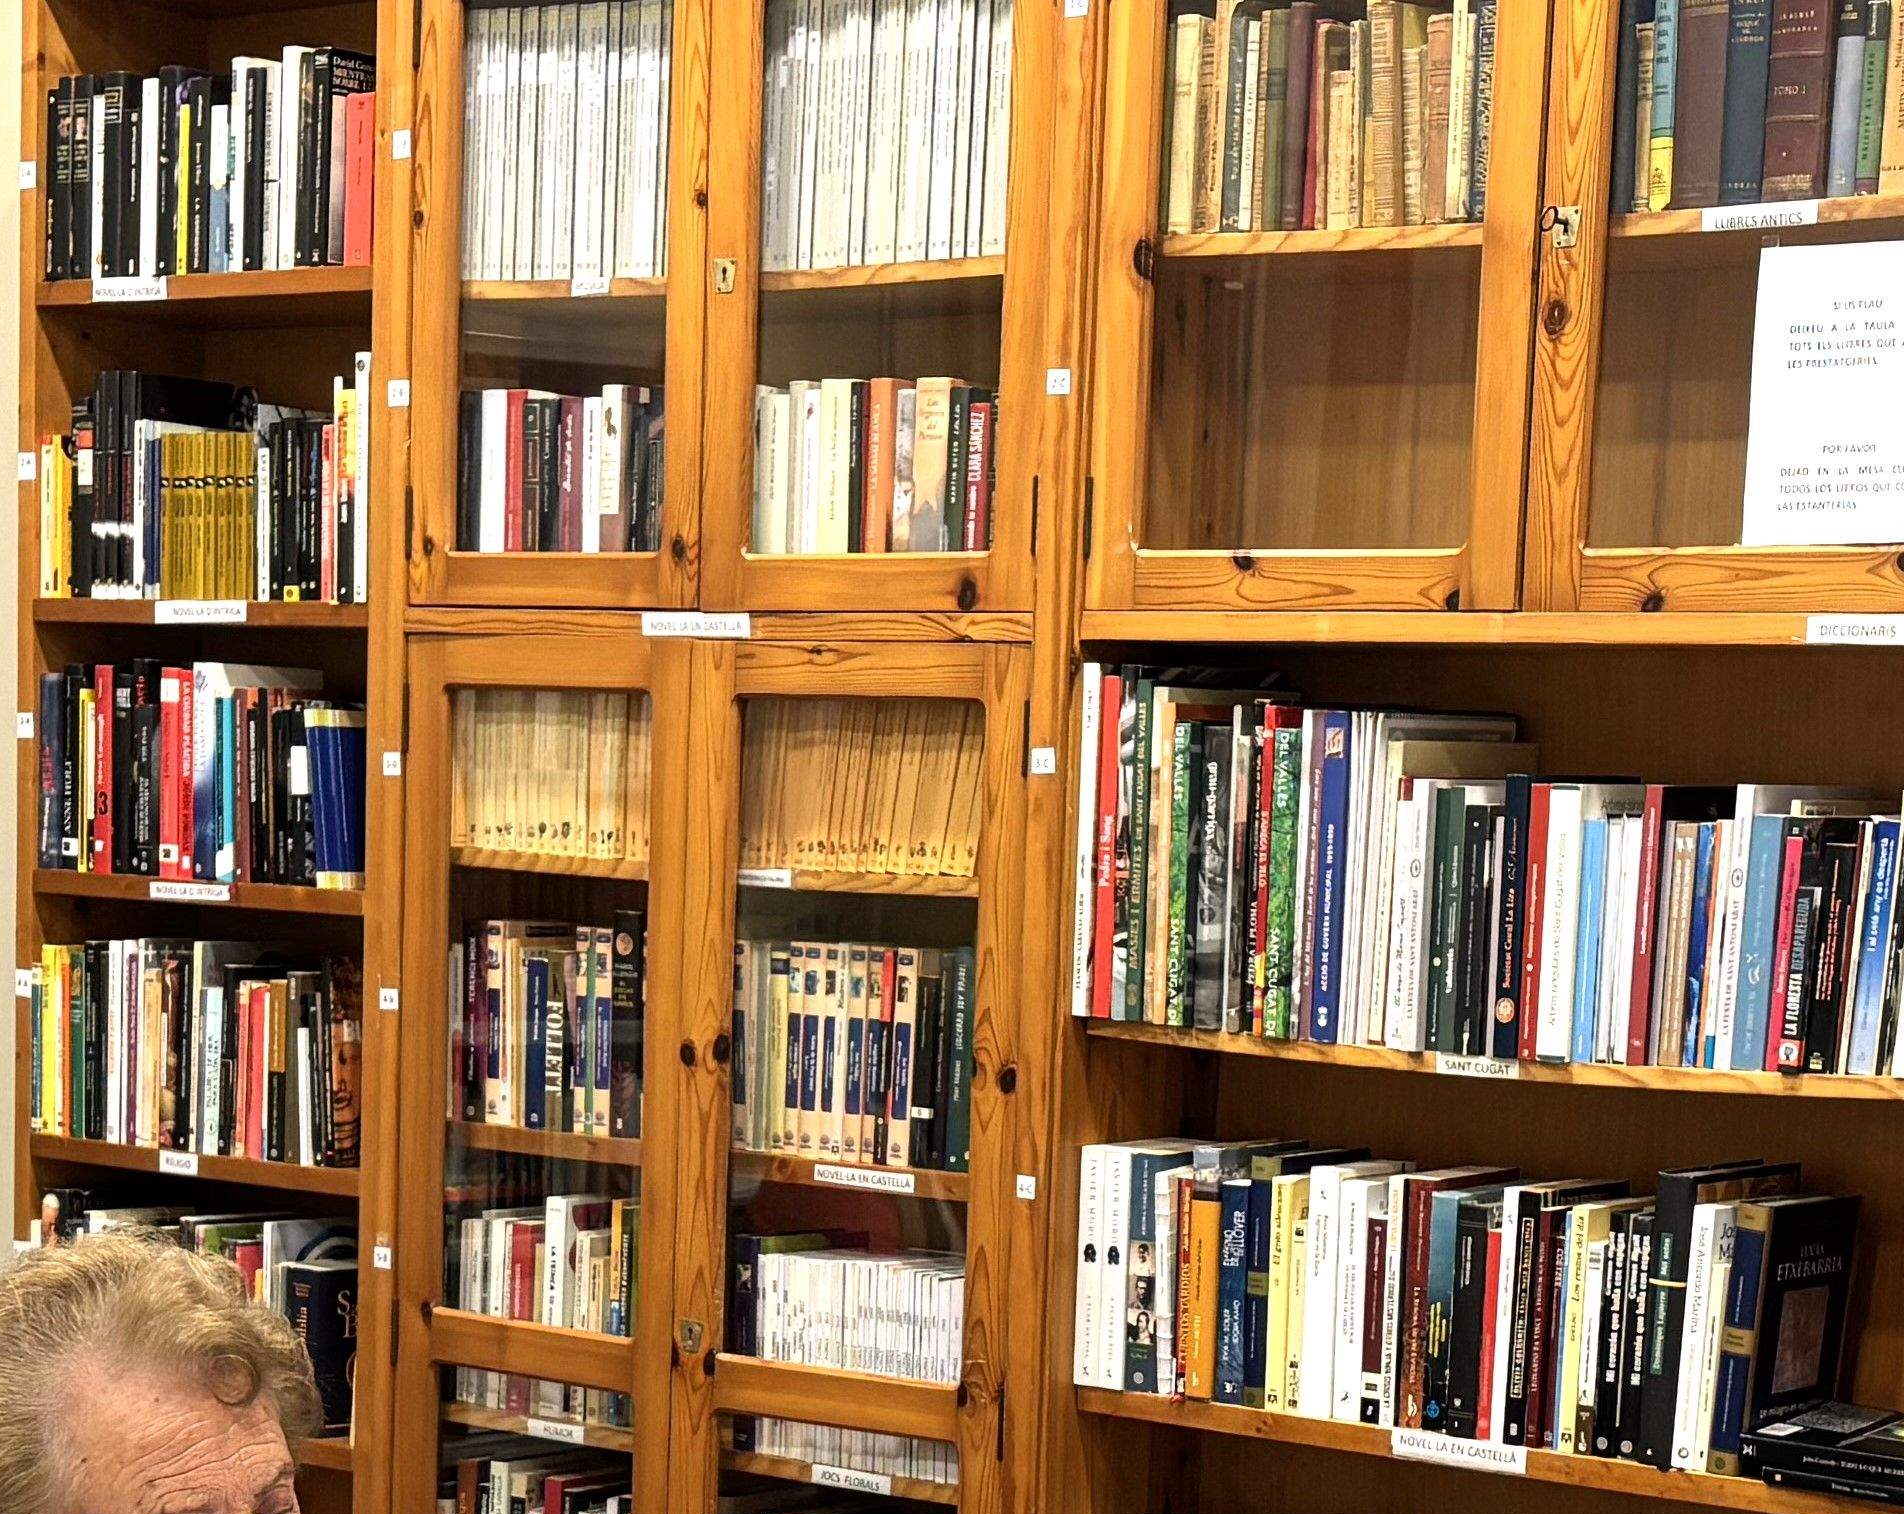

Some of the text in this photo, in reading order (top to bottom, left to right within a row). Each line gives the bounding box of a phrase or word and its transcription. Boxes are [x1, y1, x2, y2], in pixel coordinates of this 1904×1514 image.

[1773, 84, 1797, 97] TOMO
[1760, 211, 1803, 227] ANTICS
[1864, 321, 1895, 331] TAULA
[967, 447, 982, 483] CLARA
[1820, 623, 1896, 637] DICCIONARIS
[1175, 725, 1186, 748] DEL
[1279, 732, 1291, 755] DEL
[1167, 917, 1181, 1007] SANT CUGAT
[1267, 928, 1281, 1016] SANT CUGAT
[1785, 970, 1803, 1022] FLORESTA
[1782, 1022, 1796, 1036] LA
[544, 999, 564, 1093] FOLLETT
[1445, 1060, 1510, 1076] SANT CUGAT
[820, 1470, 880, 1492] JOCS FLORALS
